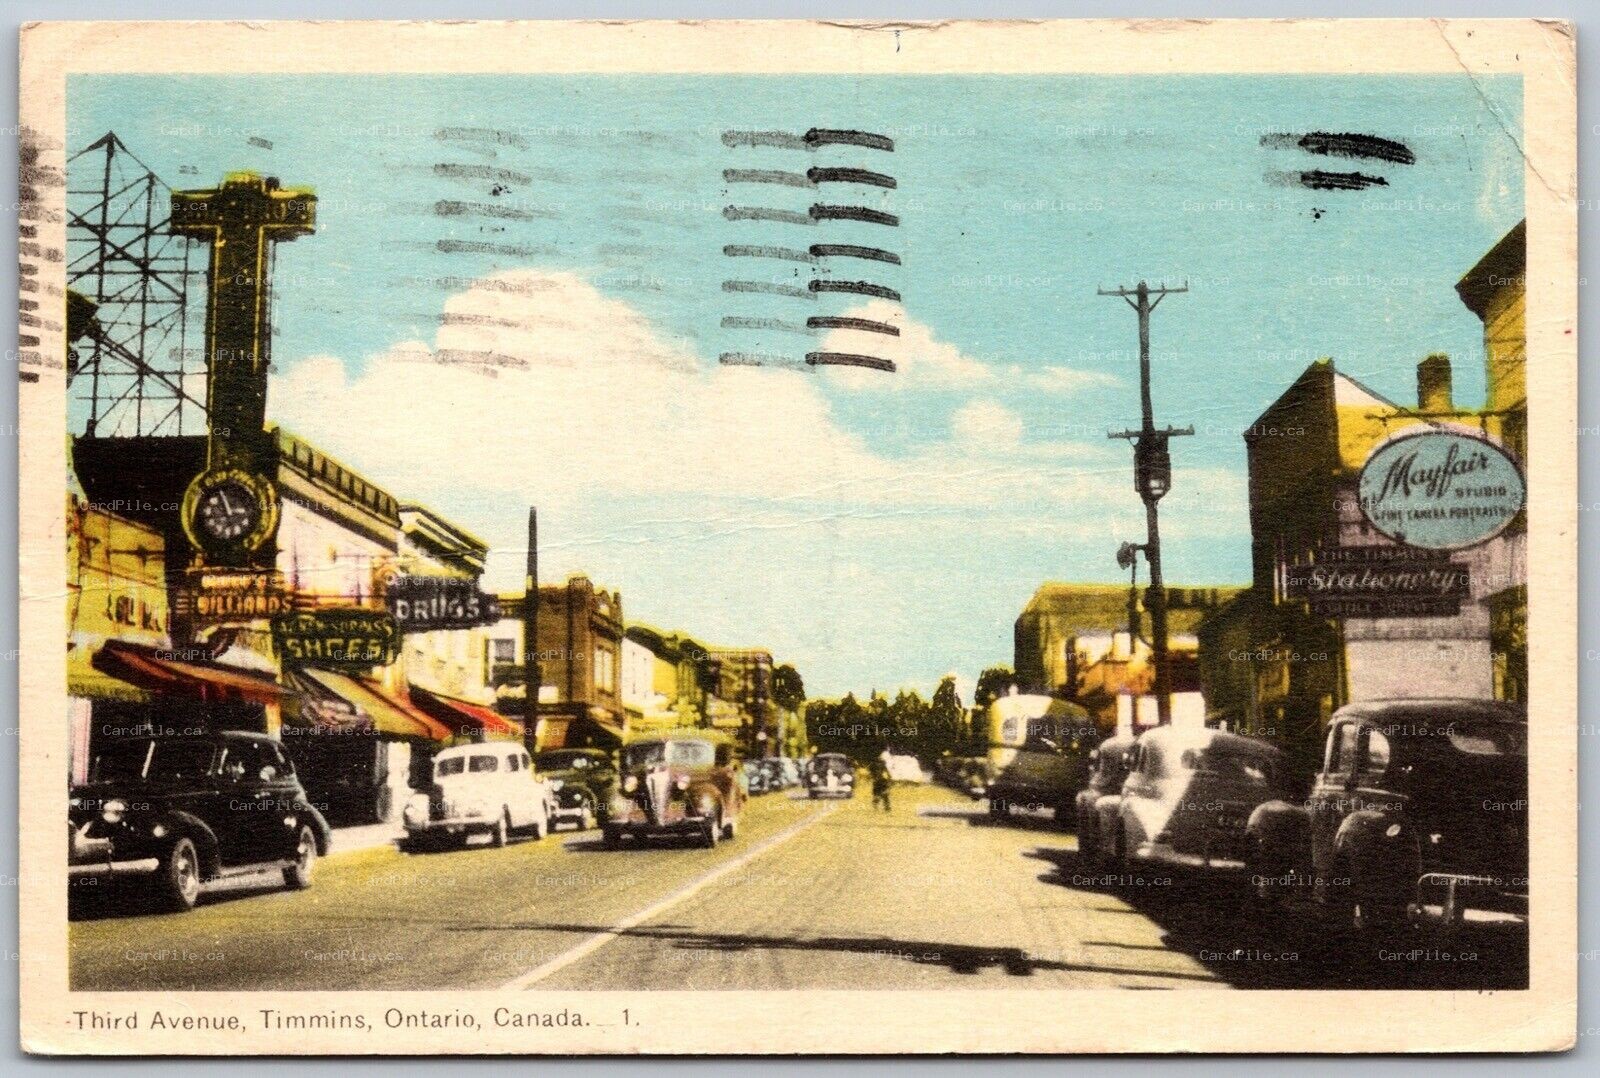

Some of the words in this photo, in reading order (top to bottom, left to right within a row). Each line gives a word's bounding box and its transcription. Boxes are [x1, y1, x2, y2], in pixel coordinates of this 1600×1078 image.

[1377, 443, 1489, 503] Mayfair
[1455, 485, 1507, 498] STUDIO
[1406, 507, 1448, 520] CAMERA
[395, 596, 481, 620] DRUGS
[72, 1011, 137, 1029] Third
[150, 1011, 246, 1032] Avenue,
[259, 1009, 371, 1030] Timmins,
[384, 1008, 480, 1030] Ontario,
[494, 1007, 590, 1027] Canada.
[622, 1007, 640, 1025] 1.
